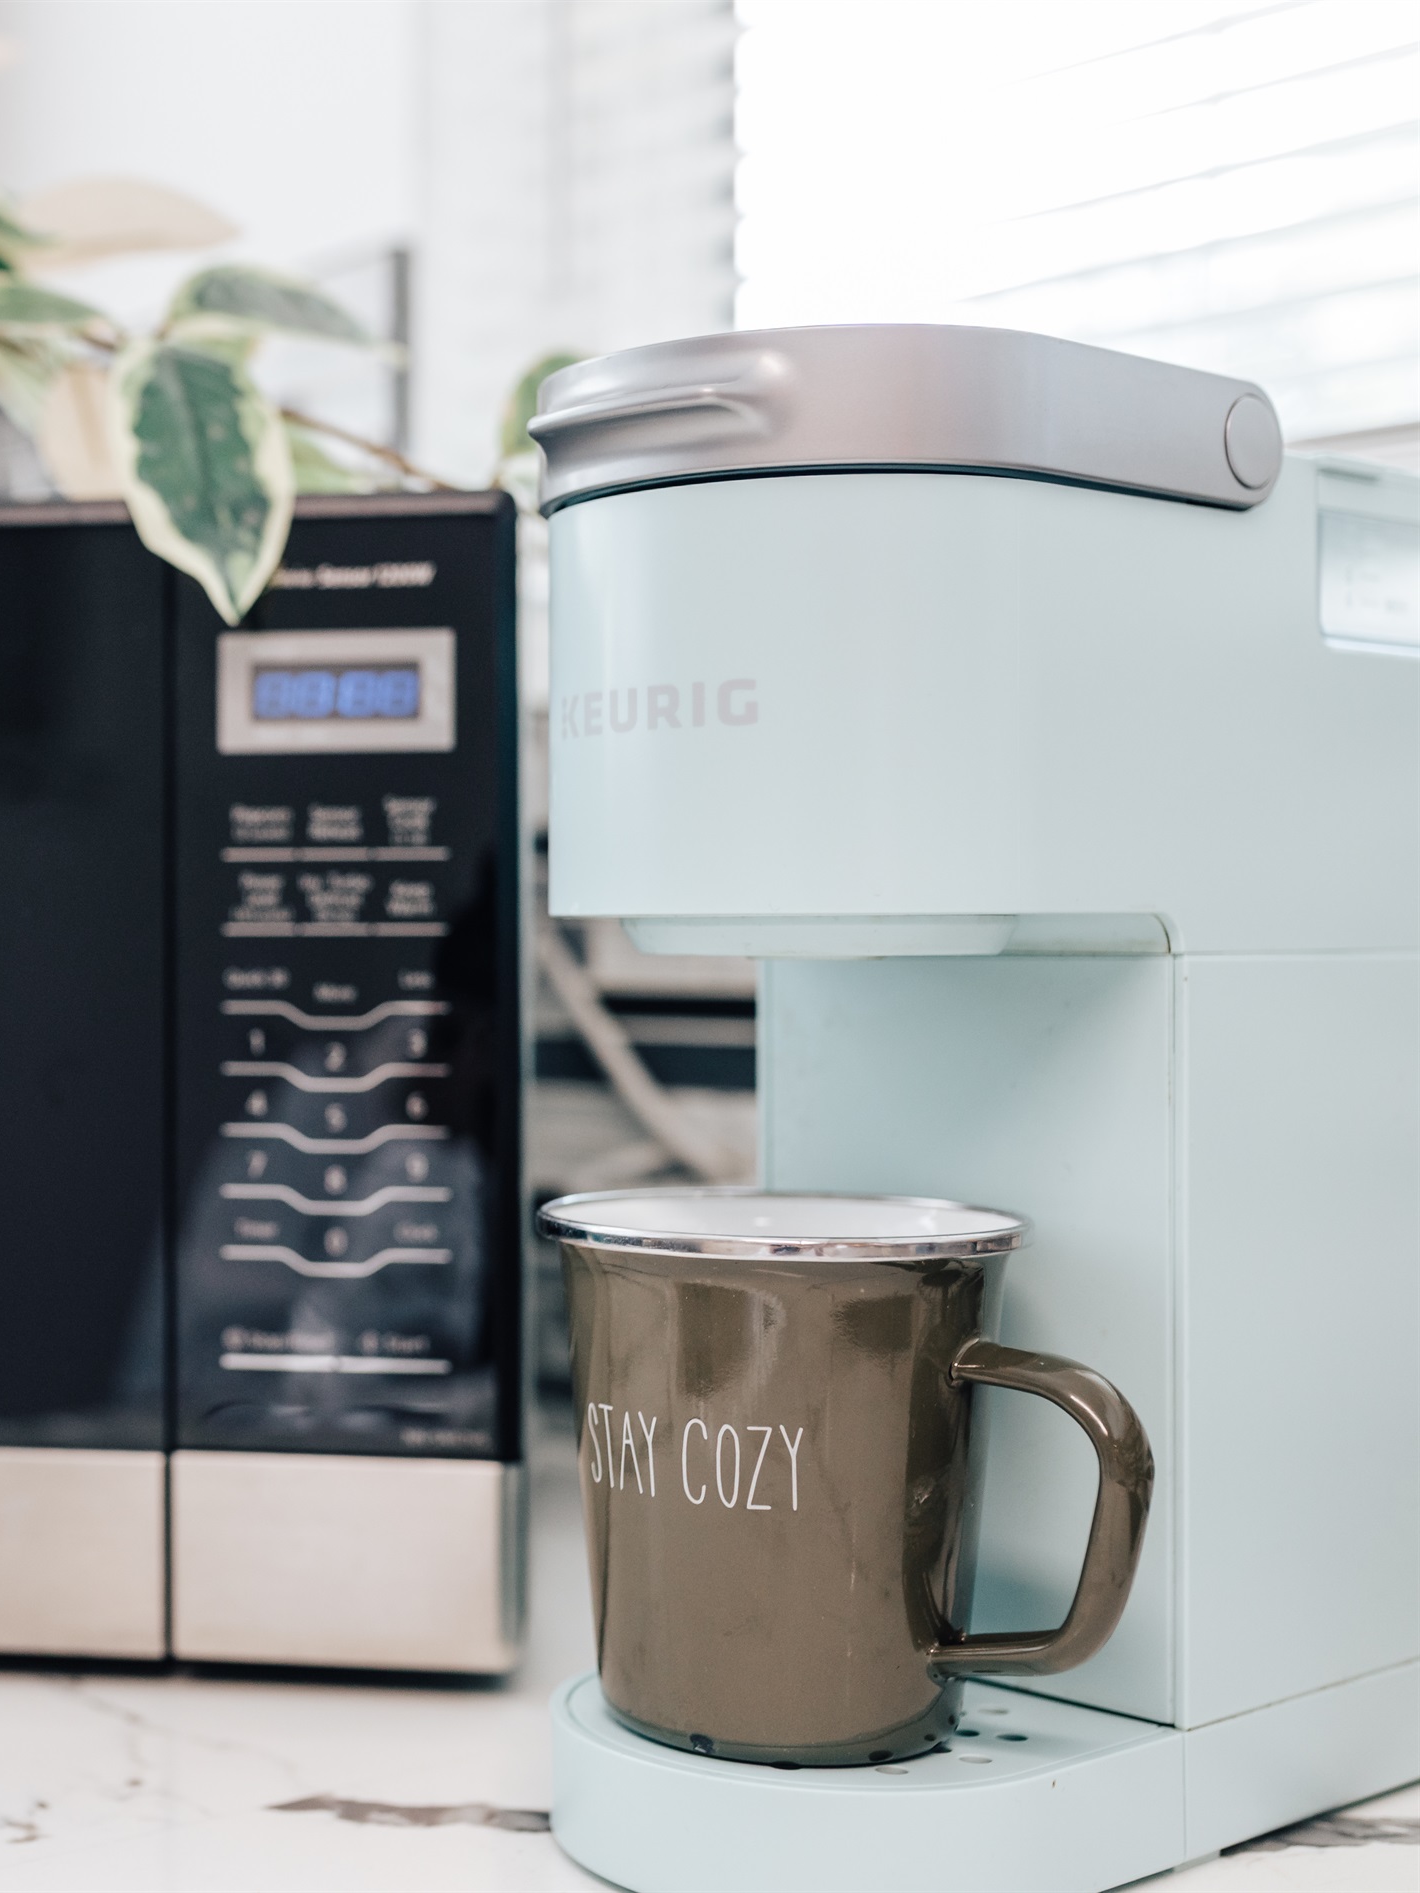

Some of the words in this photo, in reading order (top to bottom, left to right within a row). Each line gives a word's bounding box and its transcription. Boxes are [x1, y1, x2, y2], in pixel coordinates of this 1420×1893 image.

[560, 678, 759, 741] KEURIG
[249, 1027, 265, 1056] 1
[325, 1041, 347, 1073] 2
[407, 1027, 428, 1060] 3
[246, 1089, 268, 1118] 4
[325, 1102, 347, 1134] 5
[406, 1090, 428, 1121] 6
[247, 1148, 269, 1180] 7
[324, 1164, 348, 1196] 8
[406, 1150, 429, 1184] 9
[587, 1402, 657, 1498] STAY
[682, 1417, 804, 1512] COZY
